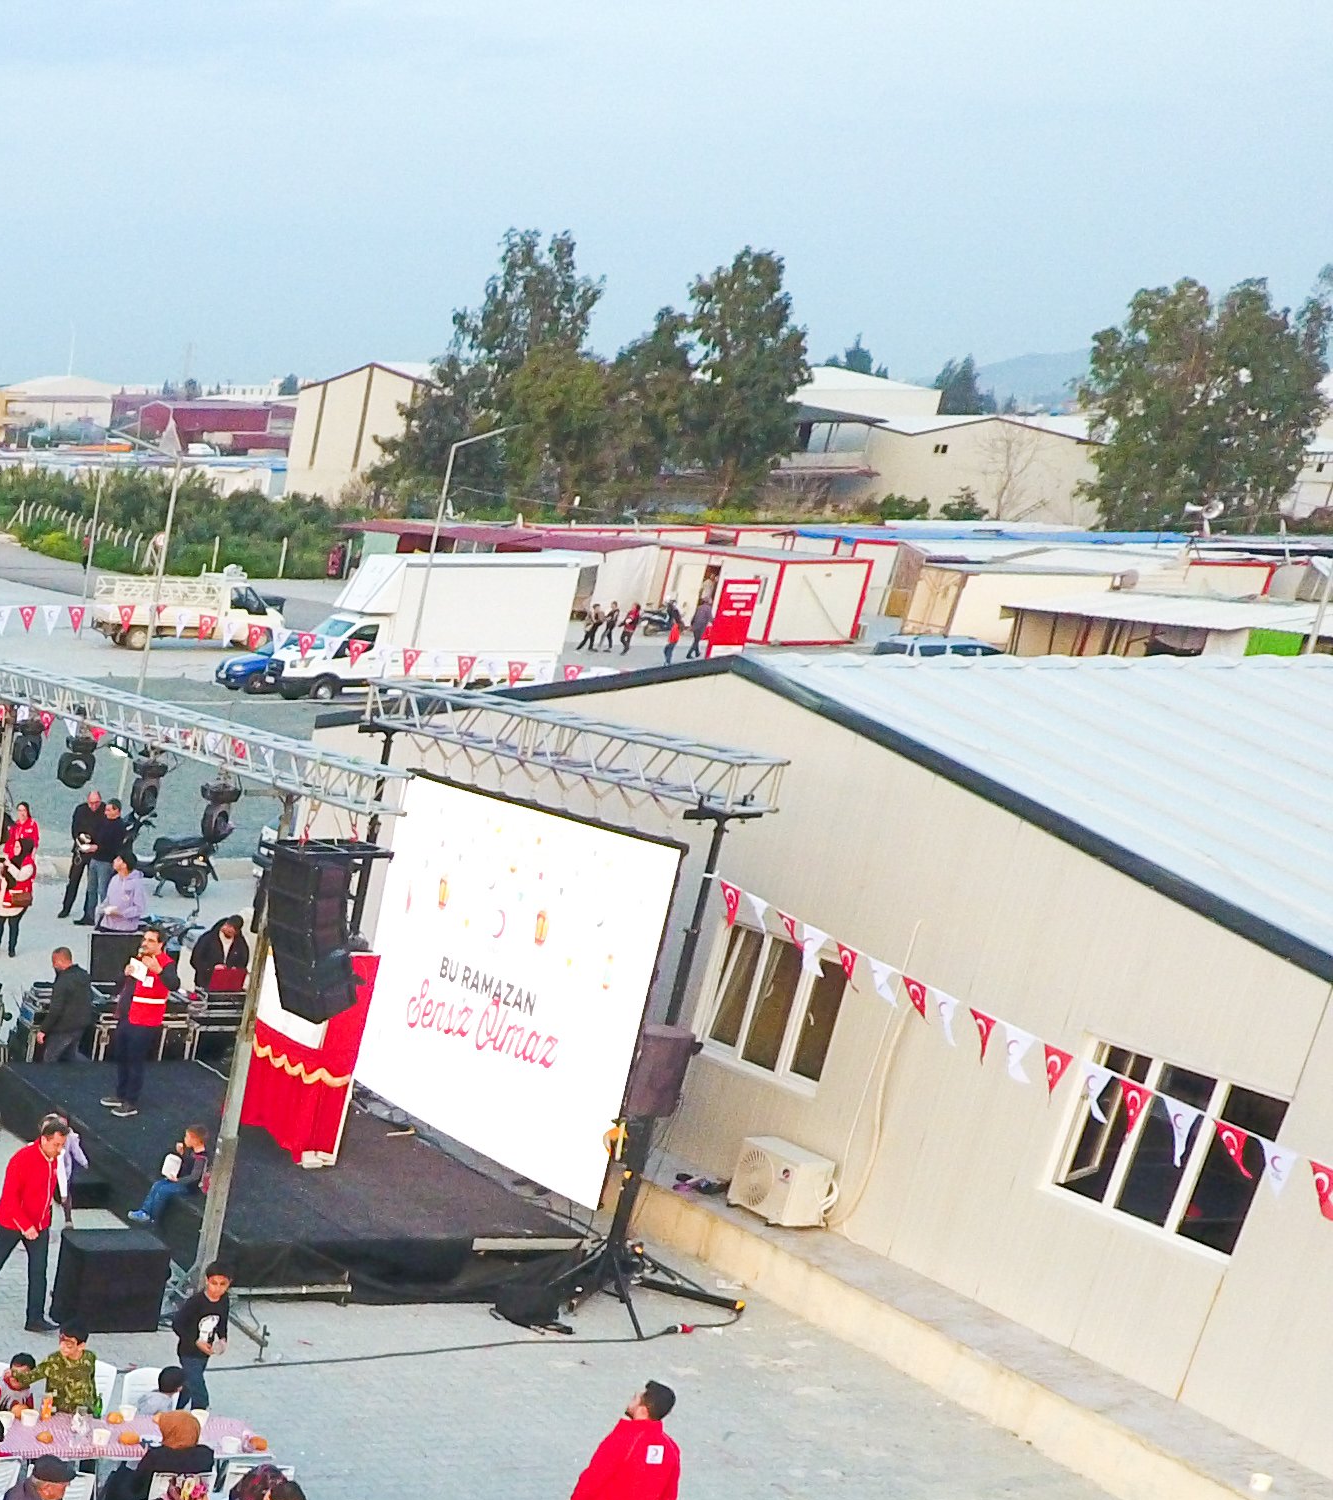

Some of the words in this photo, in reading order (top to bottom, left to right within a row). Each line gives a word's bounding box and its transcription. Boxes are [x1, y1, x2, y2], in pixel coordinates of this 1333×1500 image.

[407, 978, 473, 1037] Sensiz
[475, 998, 558, 1068] Olmaz
[440, 956, 459, 982] BU
[461, 965, 536, 1016] RAMAZAN
